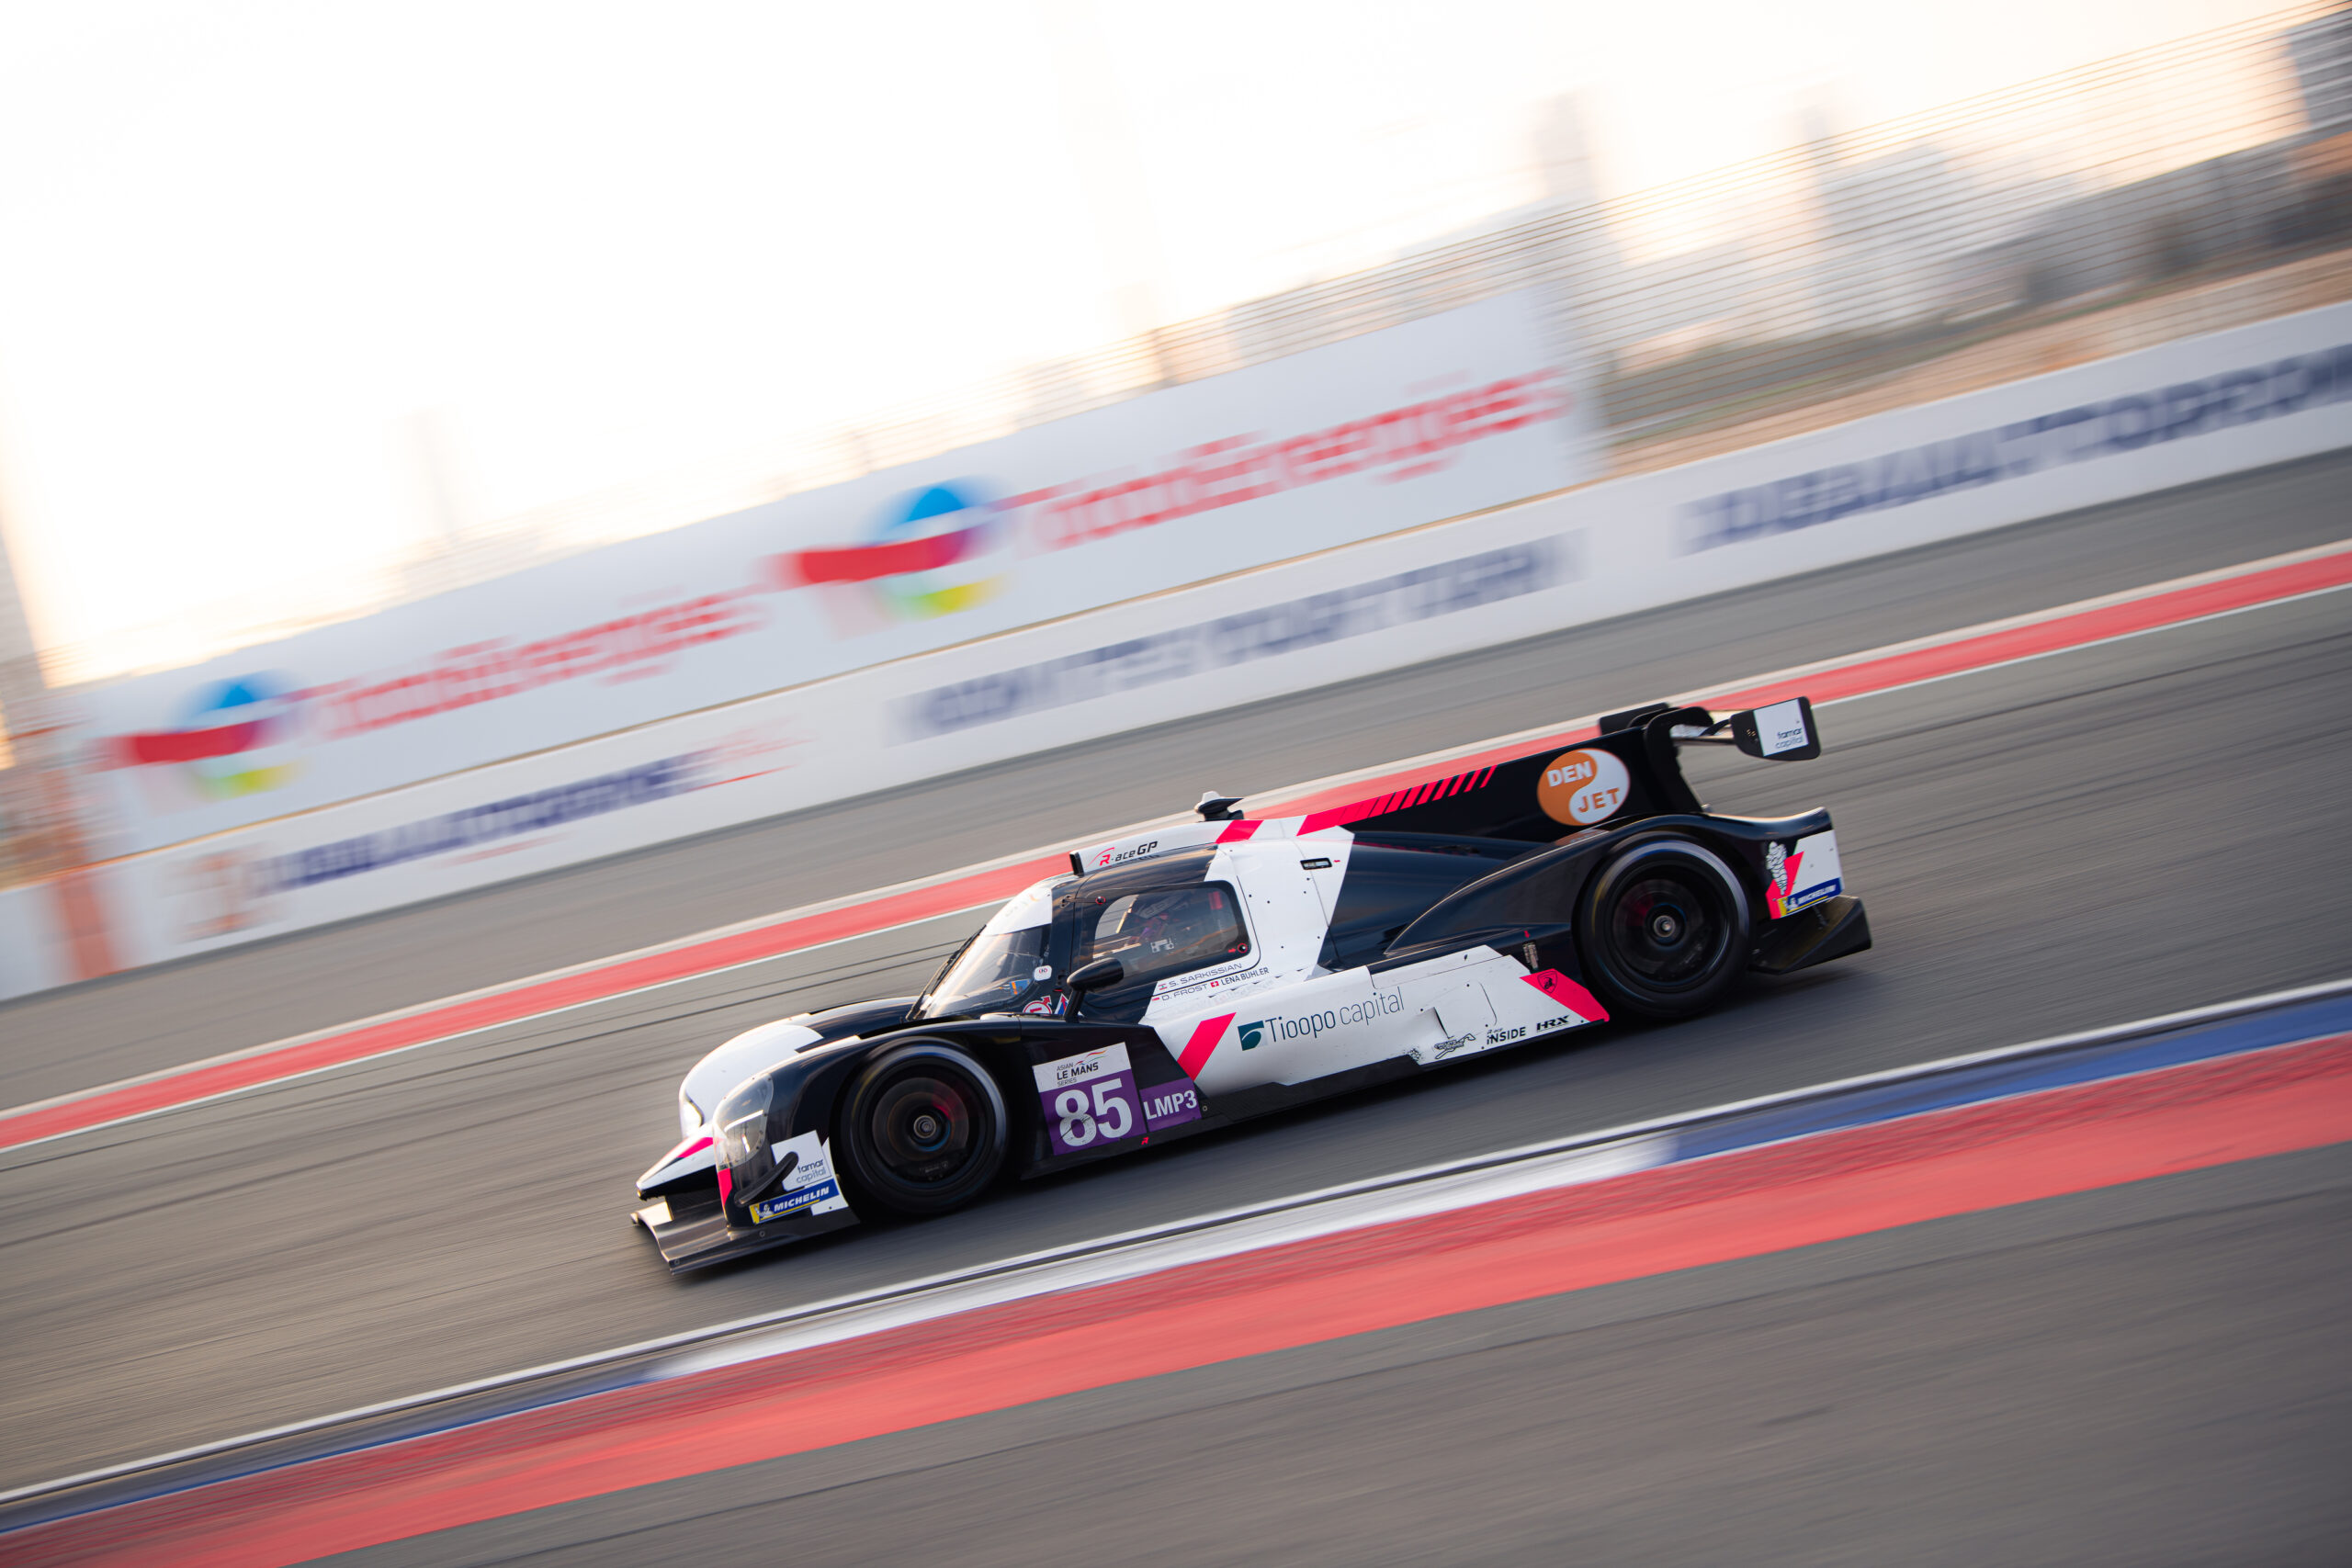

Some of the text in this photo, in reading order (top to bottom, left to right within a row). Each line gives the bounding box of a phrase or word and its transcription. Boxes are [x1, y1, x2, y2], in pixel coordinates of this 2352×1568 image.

[1547, 761, 1593, 787] DEN
[1578, 787, 1620, 813] JET
[1180, 962, 1242, 985] SARKISSIAN
[1221, 975, 1240, 986] LENA
[1173, 983, 1208, 998] FROST
[1265, 986, 1405, 1043] Tioopo capital
[1057, 1063, 1074, 1072] ASIAN
[1057, 1062, 1099, 1081] LE MANS
[1057, 1077, 1078, 1088] SERIES
[1055, 1077, 1133, 1146] 85
[1143, 1089, 1197, 1120] LMP3
[796, 1167, 826, 1184] capital
[797, 1159, 824, 1174] tamar
[774, 1186, 830, 1213] MICHELIN
